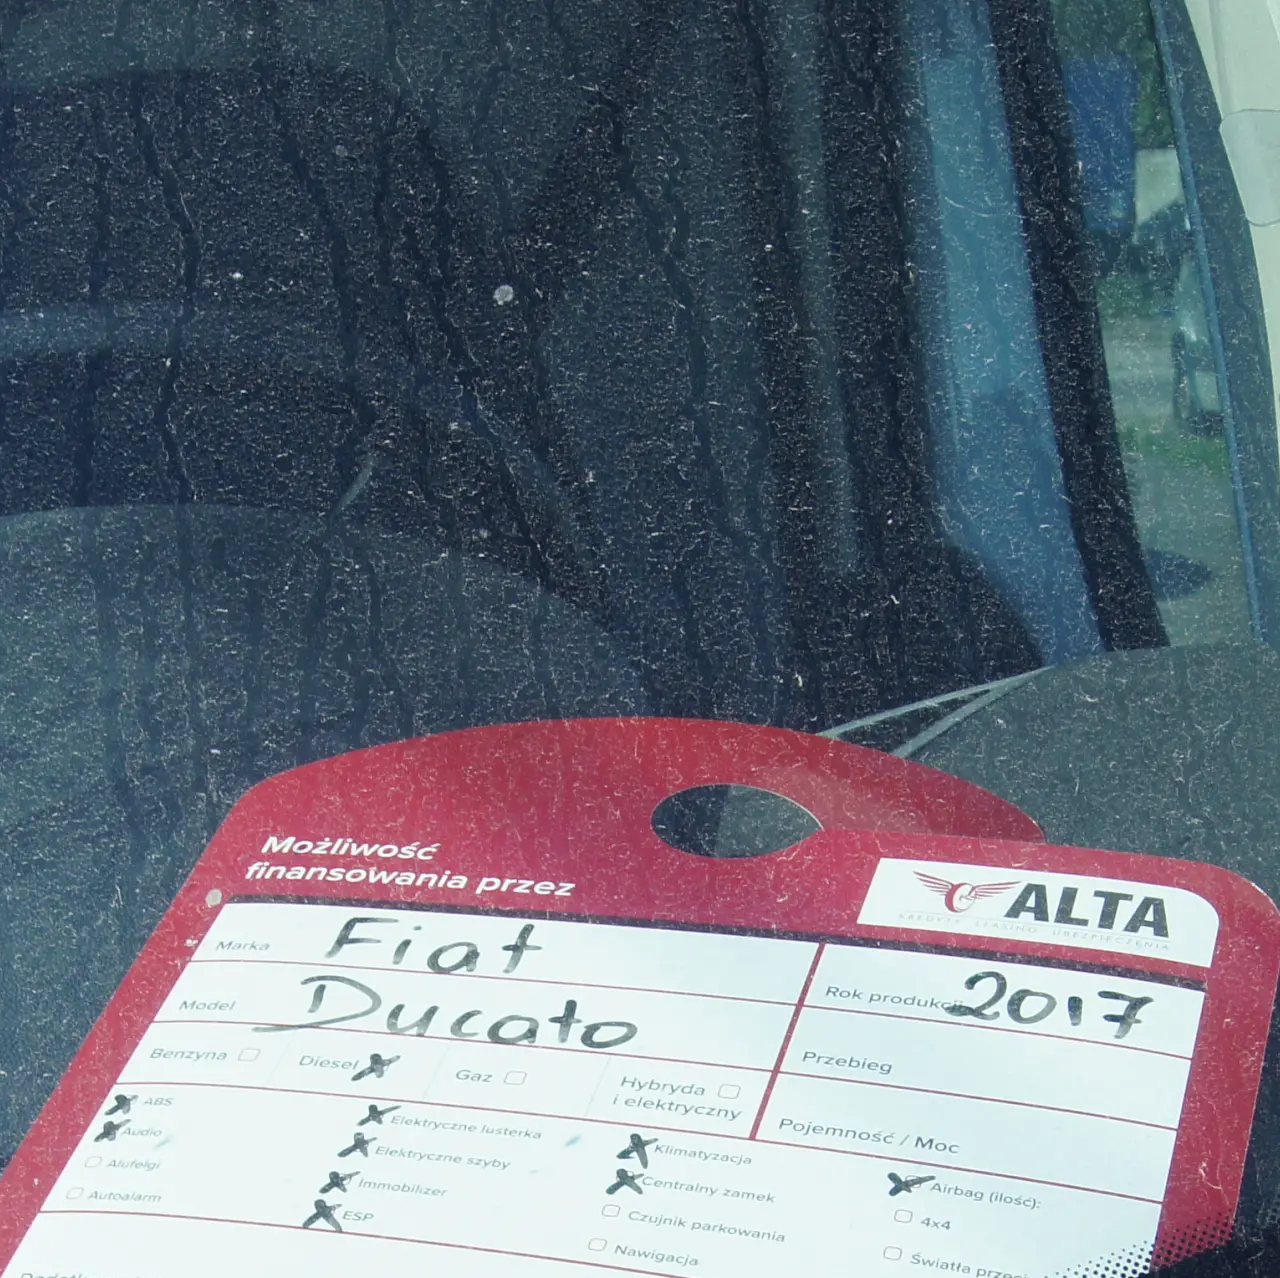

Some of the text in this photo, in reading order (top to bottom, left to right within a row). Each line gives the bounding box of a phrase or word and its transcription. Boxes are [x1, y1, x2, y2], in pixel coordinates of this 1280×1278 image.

[261, 835, 441, 860] Możliwość
[245, 861, 576, 897] finansowania przez
[1004, 883, 1170, 938] ALTA
[215, 938, 271, 953] Marka
[325, 916, 543, 975] Fiat
[179, 997, 236, 1013] Model
[825, 985, 864, 1001] Rok
[945, 970, 1154, 1040] 2017
[251, 974, 638, 1050] Ducato
[149, 1046, 228, 1064] Benzyna
[298, 1053, 359, 1073] Diesel
[802, 1049, 894, 1076] Przebieg
[455, 1068, 494, 1085] Gaz
[620, 1075, 706, 1101] Hybryda
[143, 1096, 173, 1107] ABS
[623, 1095, 742, 1123] elektryczny
[121, 1126, 162, 1138] Audio
[390, 1114, 542, 1140] Elektryczne lusterka
[779, 1116, 897, 1148] Pojemność
[915, 1134, 960, 1155] Moc
[107, 1158, 161, 1171] Alufelgi
[375, 1145, 512, 1171] Elektryczne szyby
[653, 1142, 753, 1167] Klimatyzacja
[88, 1190, 162, 1203] Autoalarm
[358, 1177, 448, 1198] Immobilizer
[642, 1175, 776, 1204] Centralny zamek
[930, 1182, 1041, 1210] Airbag (ilość):
[342, 1210, 374, 1223] ESP
[627, 1208, 787, 1244] Czujnik parkowania
[920, 1216, 951, 1231] 4x4
[614, 1243, 699, 1268] Nawigacja
[910, 1251, 971, 1275] Światła
